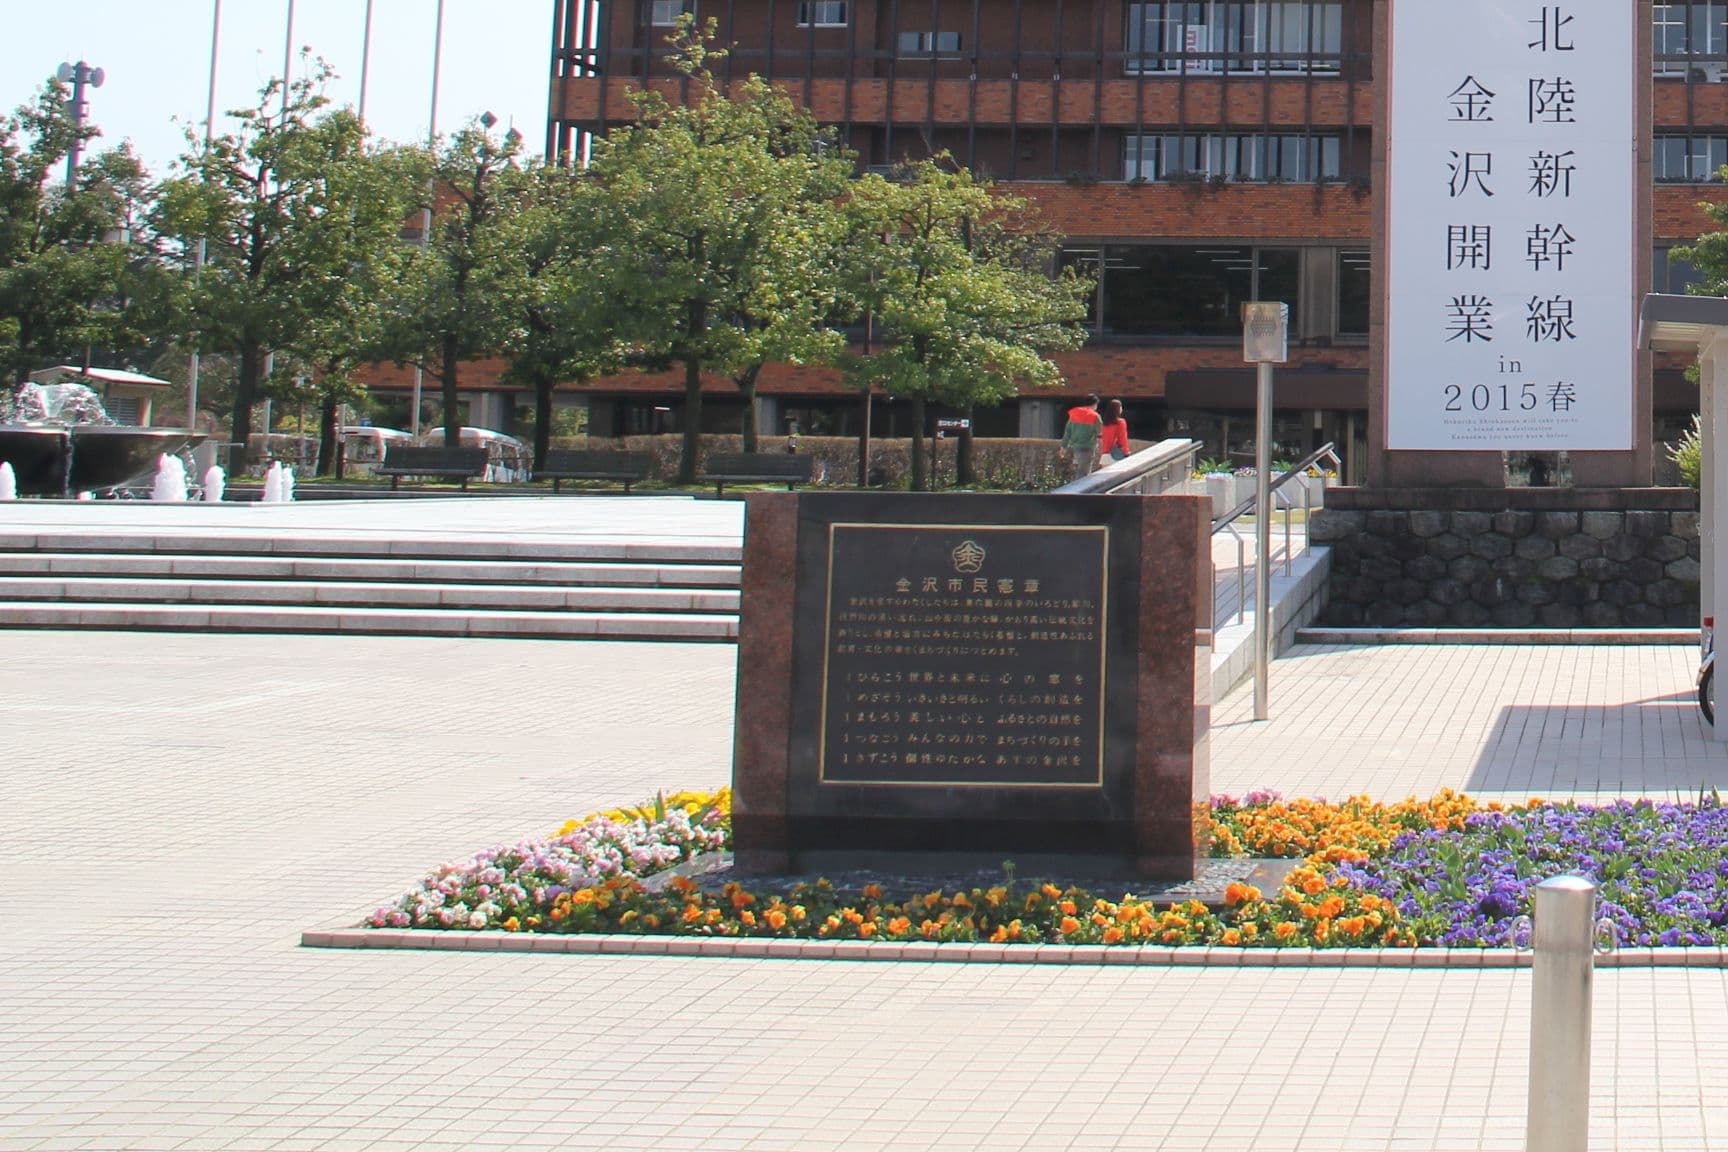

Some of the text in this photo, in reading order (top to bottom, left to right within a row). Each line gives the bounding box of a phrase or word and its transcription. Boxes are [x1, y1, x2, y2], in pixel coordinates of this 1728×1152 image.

[1525, 6, 1577, 343] 北陸新幹線
[1444, 75, 1496, 343] 金沢開業
[1498, 354, 1522, 373] in
[1444, 381, 1576, 412] 2015春
[895, 576, 1040, 594] 金沢市民憲章
